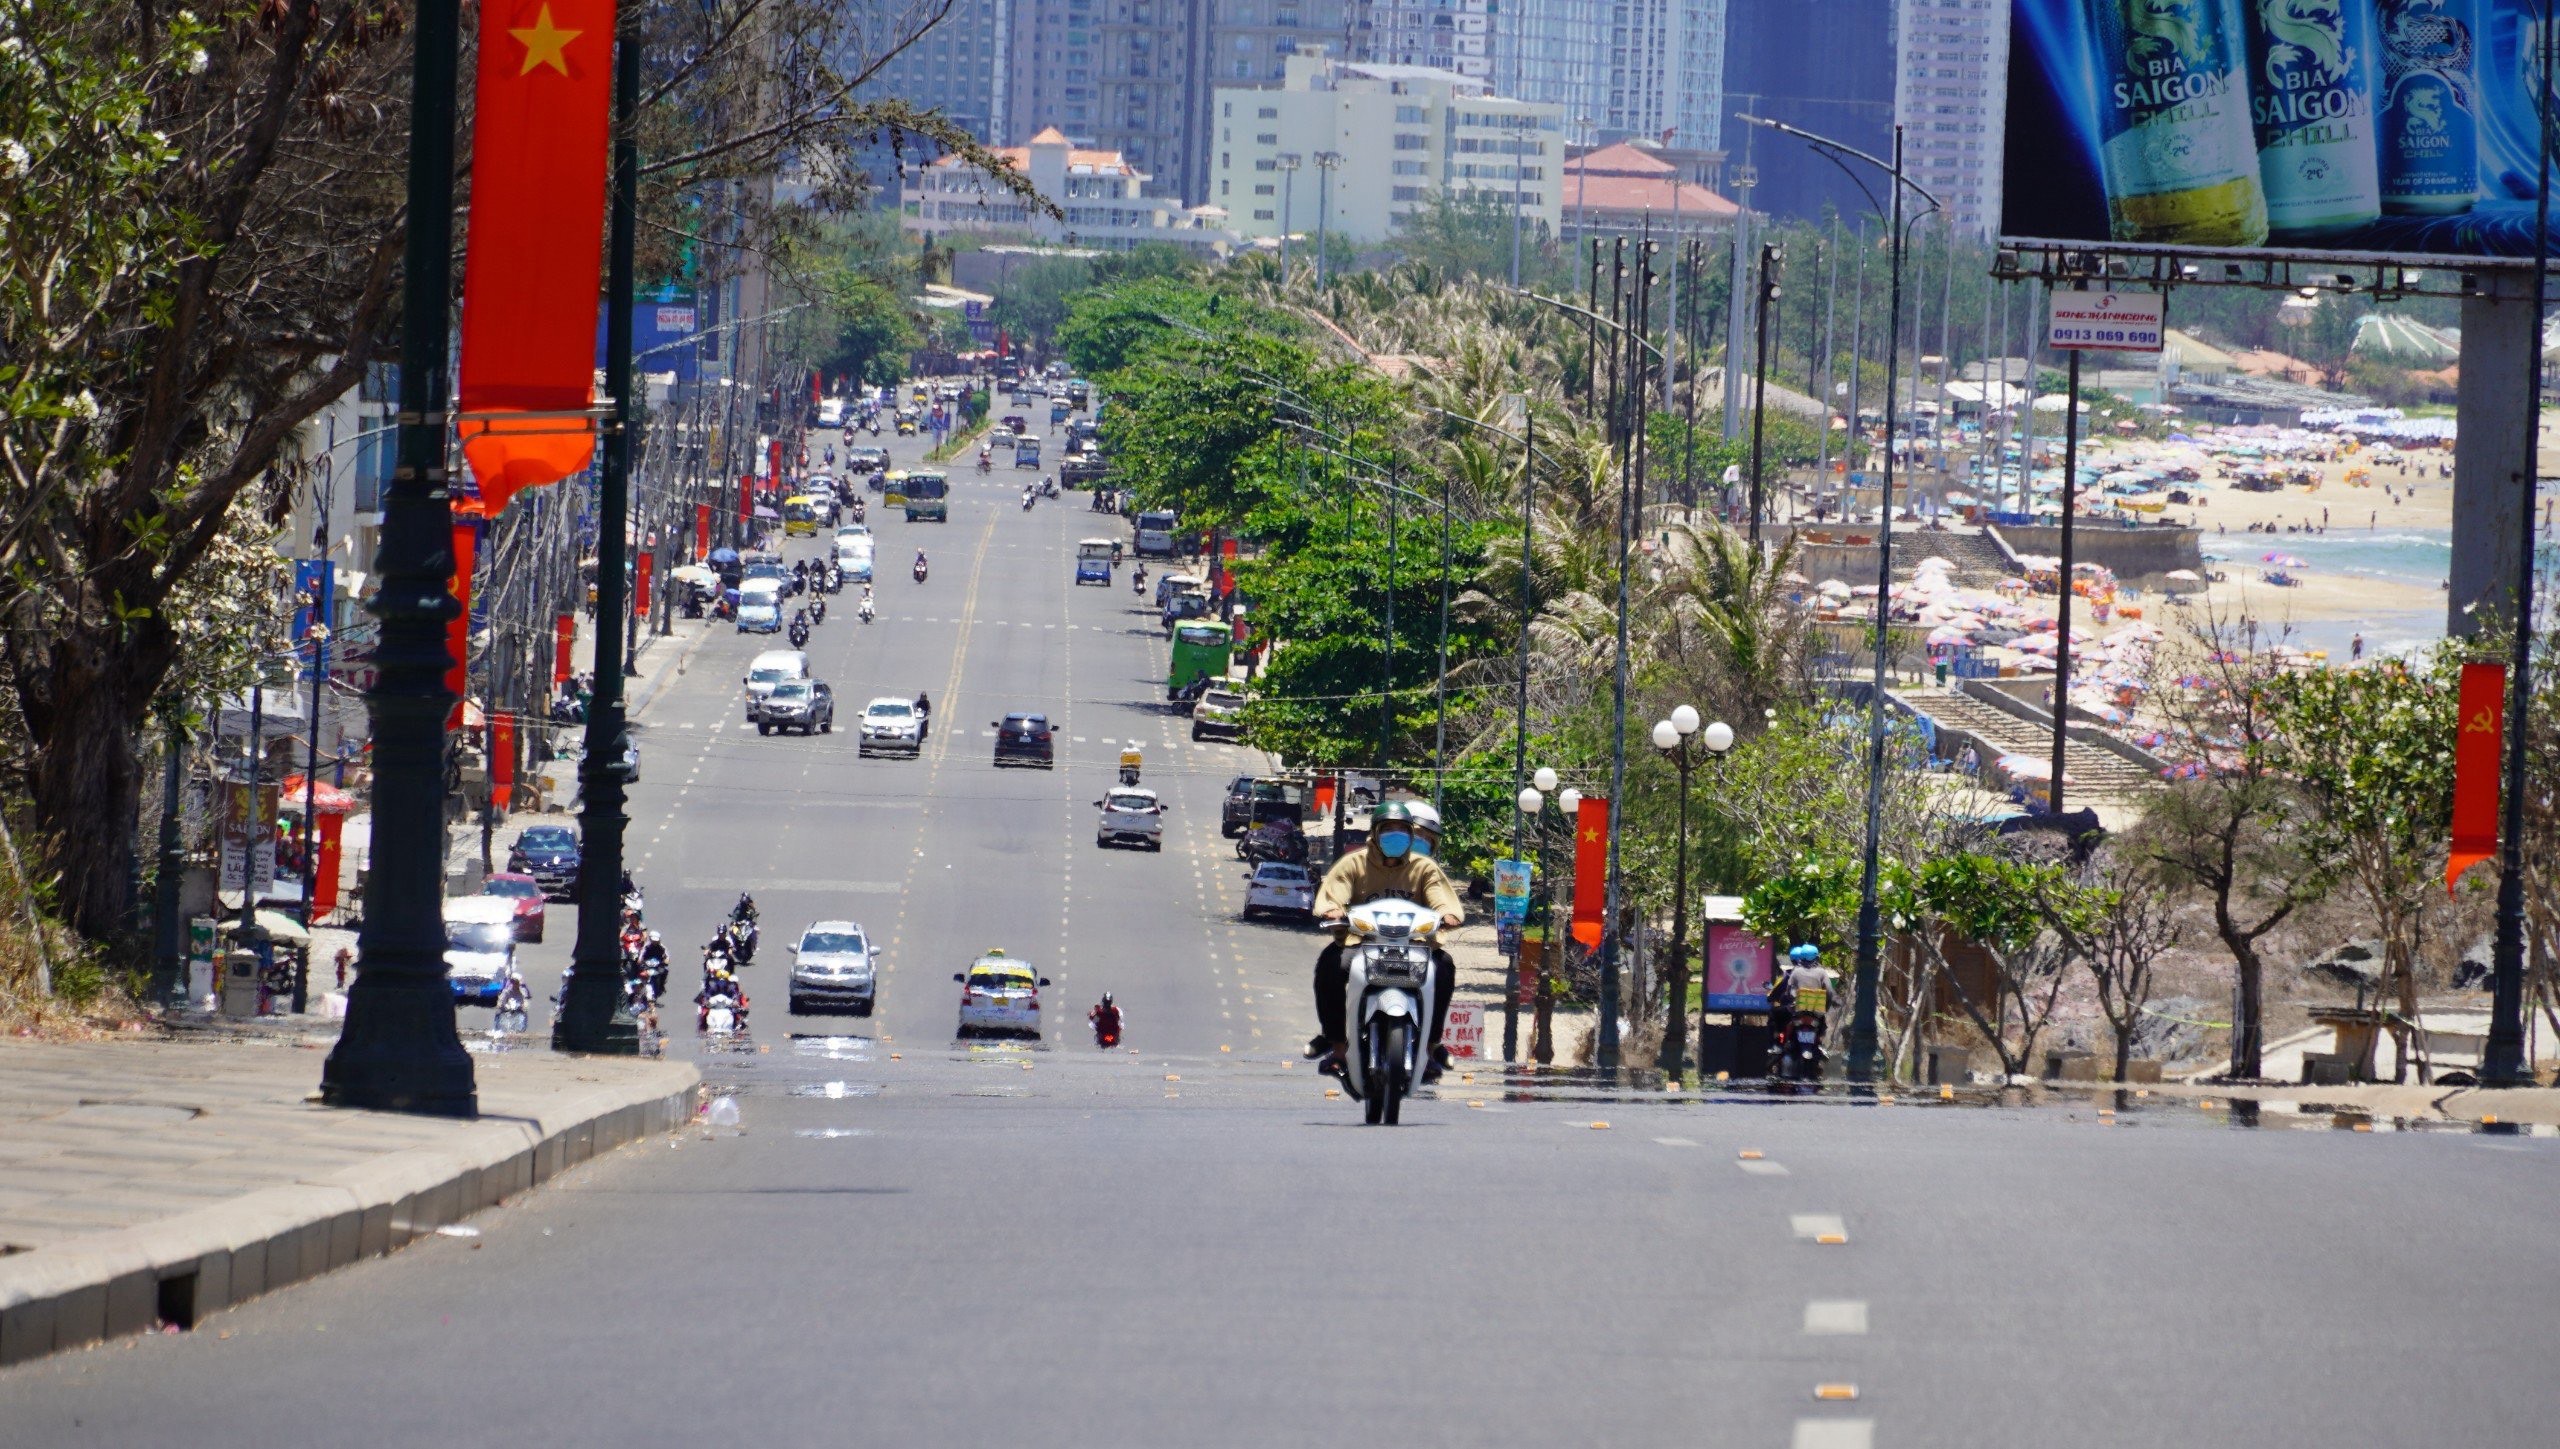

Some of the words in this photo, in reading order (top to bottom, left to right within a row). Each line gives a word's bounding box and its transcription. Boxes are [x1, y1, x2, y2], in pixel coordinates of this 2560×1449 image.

[2149, 57, 2187, 76] BIA
[2114, 68, 2227, 109] SAIGON
[2286, 69, 2328, 90] BIA
[2130, 101, 2220, 129] CHILL
[2253, 87, 2366, 124] SAIGON
[2266, 122, 2358, 148] CHILL
[2398, 135, 2450, 148] SAIGON
[2415, 128, 2432, 136] BIA
[2053, 328, 2092, 341] 0913
[2096, 330, 2125, 343] 069
[2128, 331, 2157, 344] 690
